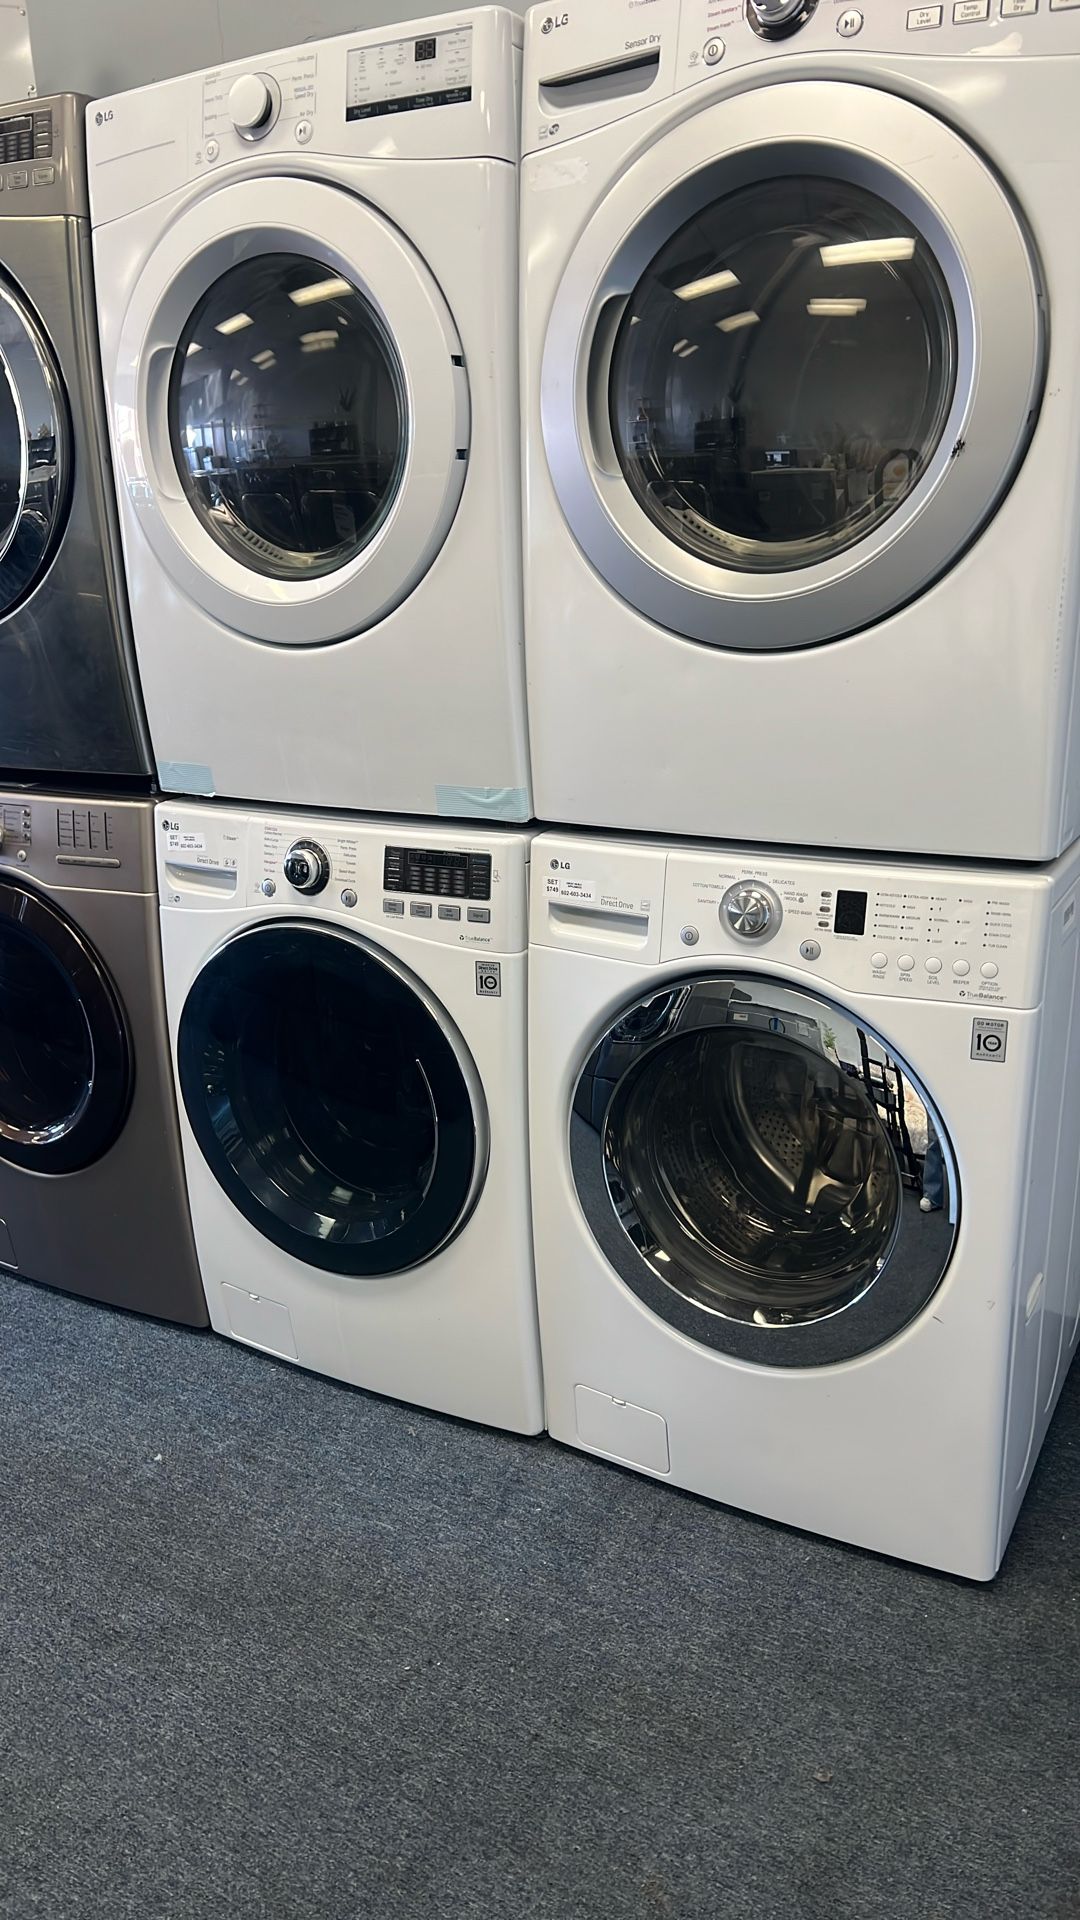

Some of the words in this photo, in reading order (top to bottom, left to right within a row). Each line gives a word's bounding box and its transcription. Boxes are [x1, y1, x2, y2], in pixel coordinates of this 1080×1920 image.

[555, 14, 568, 28] LG
[625, 37, 648, 49] Sensor
[649, 34, 661, 43] Dry
[601, 899, 618, 907] Direct
[619, 901, 634, 909] Drive
[977, 1034, 1002, 1052] 10
